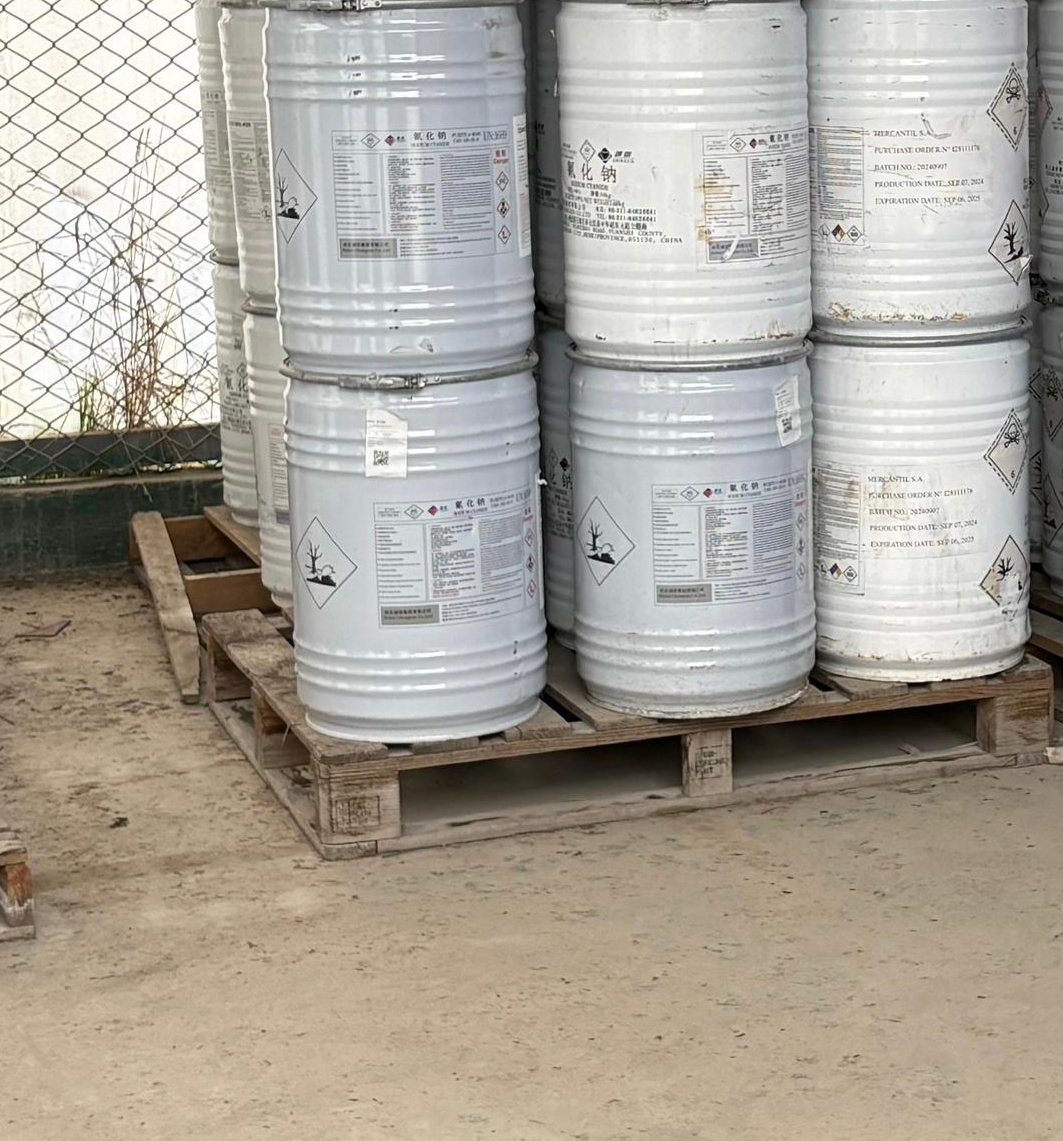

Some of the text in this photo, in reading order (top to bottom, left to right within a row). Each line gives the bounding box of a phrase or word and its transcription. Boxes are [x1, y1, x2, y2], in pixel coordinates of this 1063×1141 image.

[874, 146, 913, 154] PURCHASE
[874, 180, 923, 188] PRODUCTION
[875, 197, 919, 205] EXPIRATION
[944, 196, 956, 204] SEP
[1011, 470, 1016, 479] 6
[868, 491, 933, 499] PURCHASE ORDER
[870, 523, 916, 531] PRODUCTION
[871, 540, 913, 548] EXPIRATION
[937, 539, 950, 547] SEP
